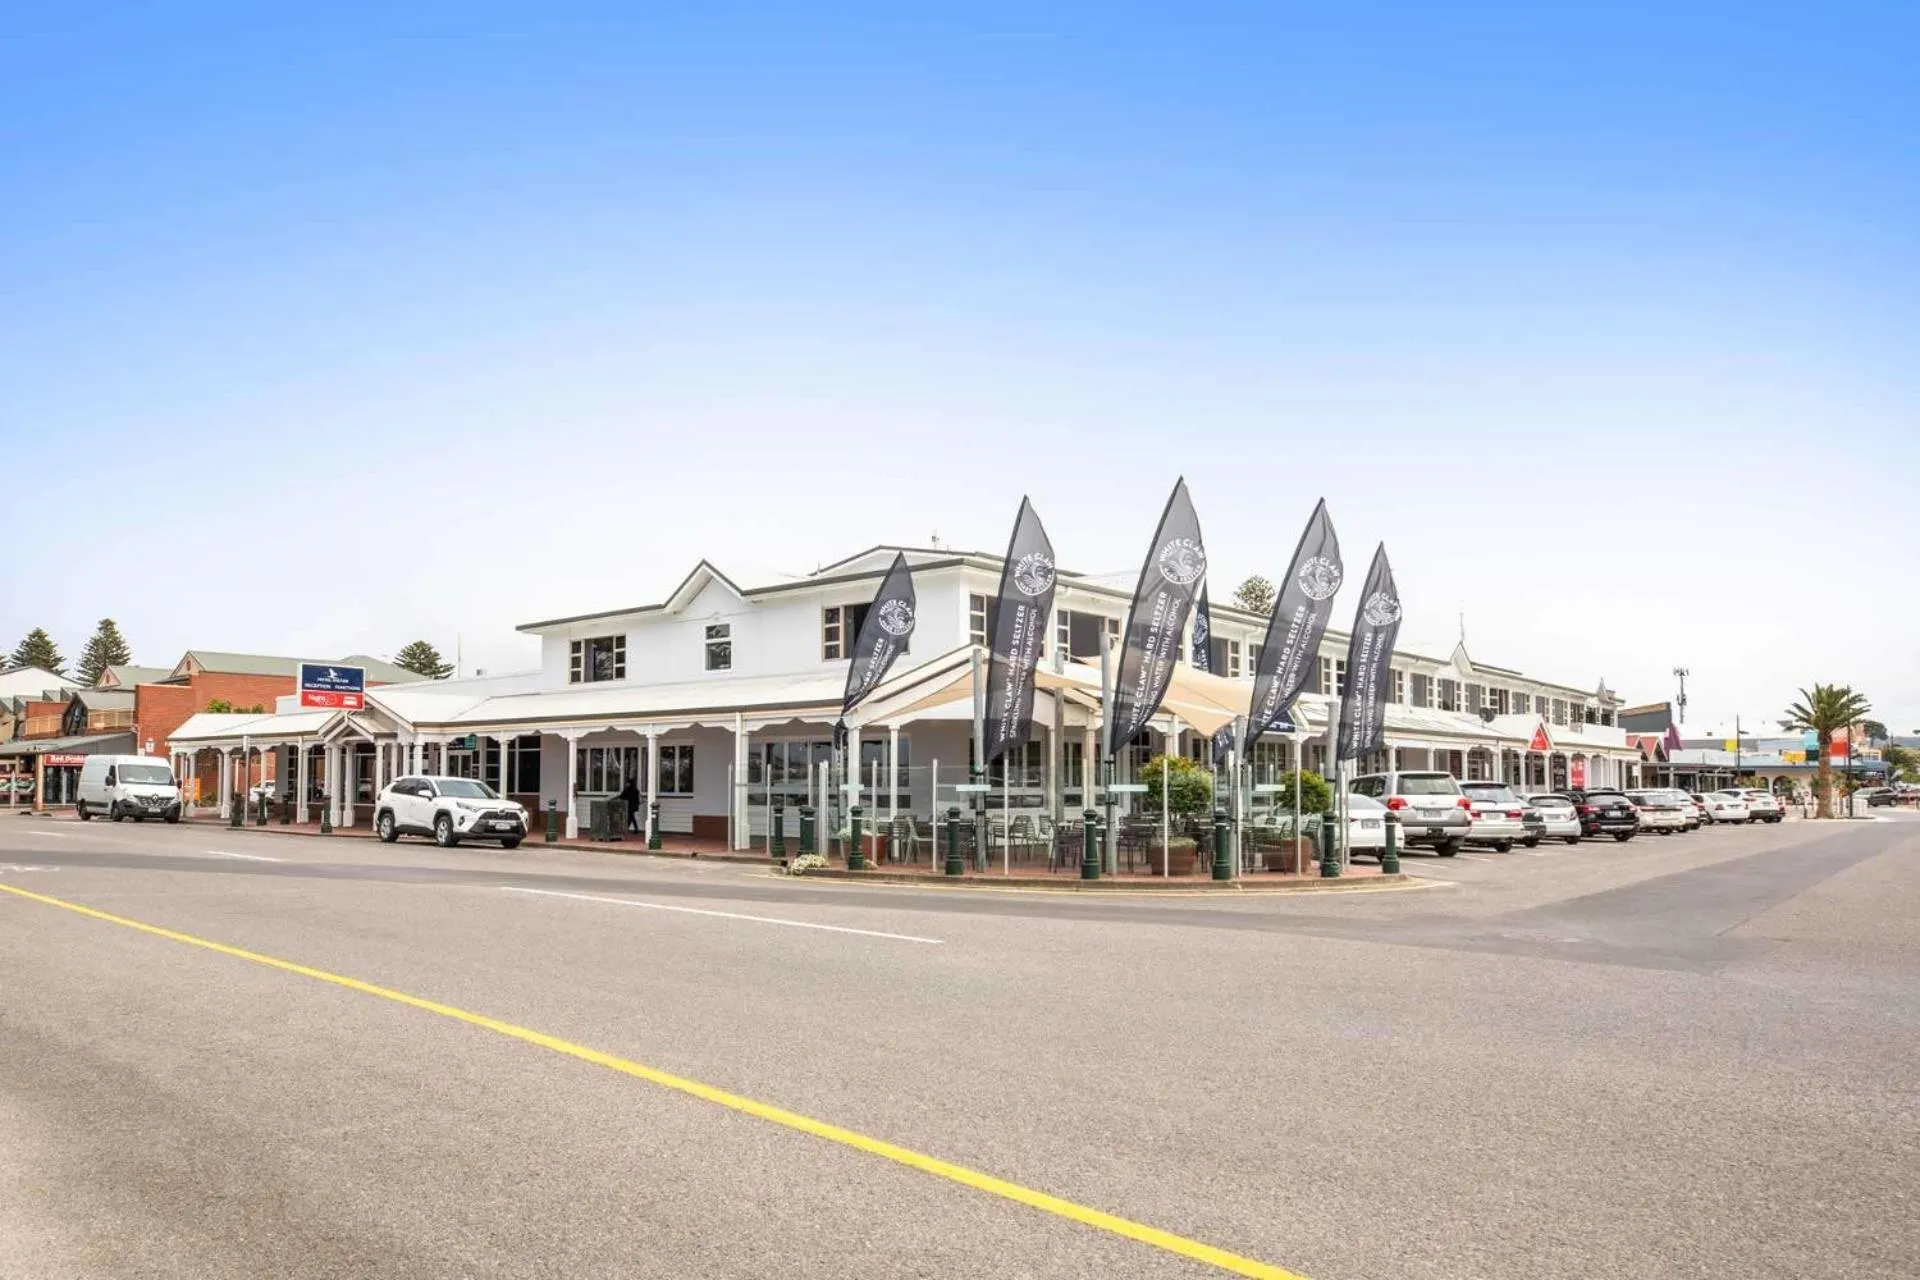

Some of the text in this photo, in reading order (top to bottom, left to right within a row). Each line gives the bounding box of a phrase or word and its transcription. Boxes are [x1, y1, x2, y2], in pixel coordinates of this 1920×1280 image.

[1012, 604, 1025, 645] SELTZER
[1142, 635, 1156, 664] HARD
[1150, 591, 1167, 633] SELTZER
[1286, 605, 1306, 645] SELTZER
